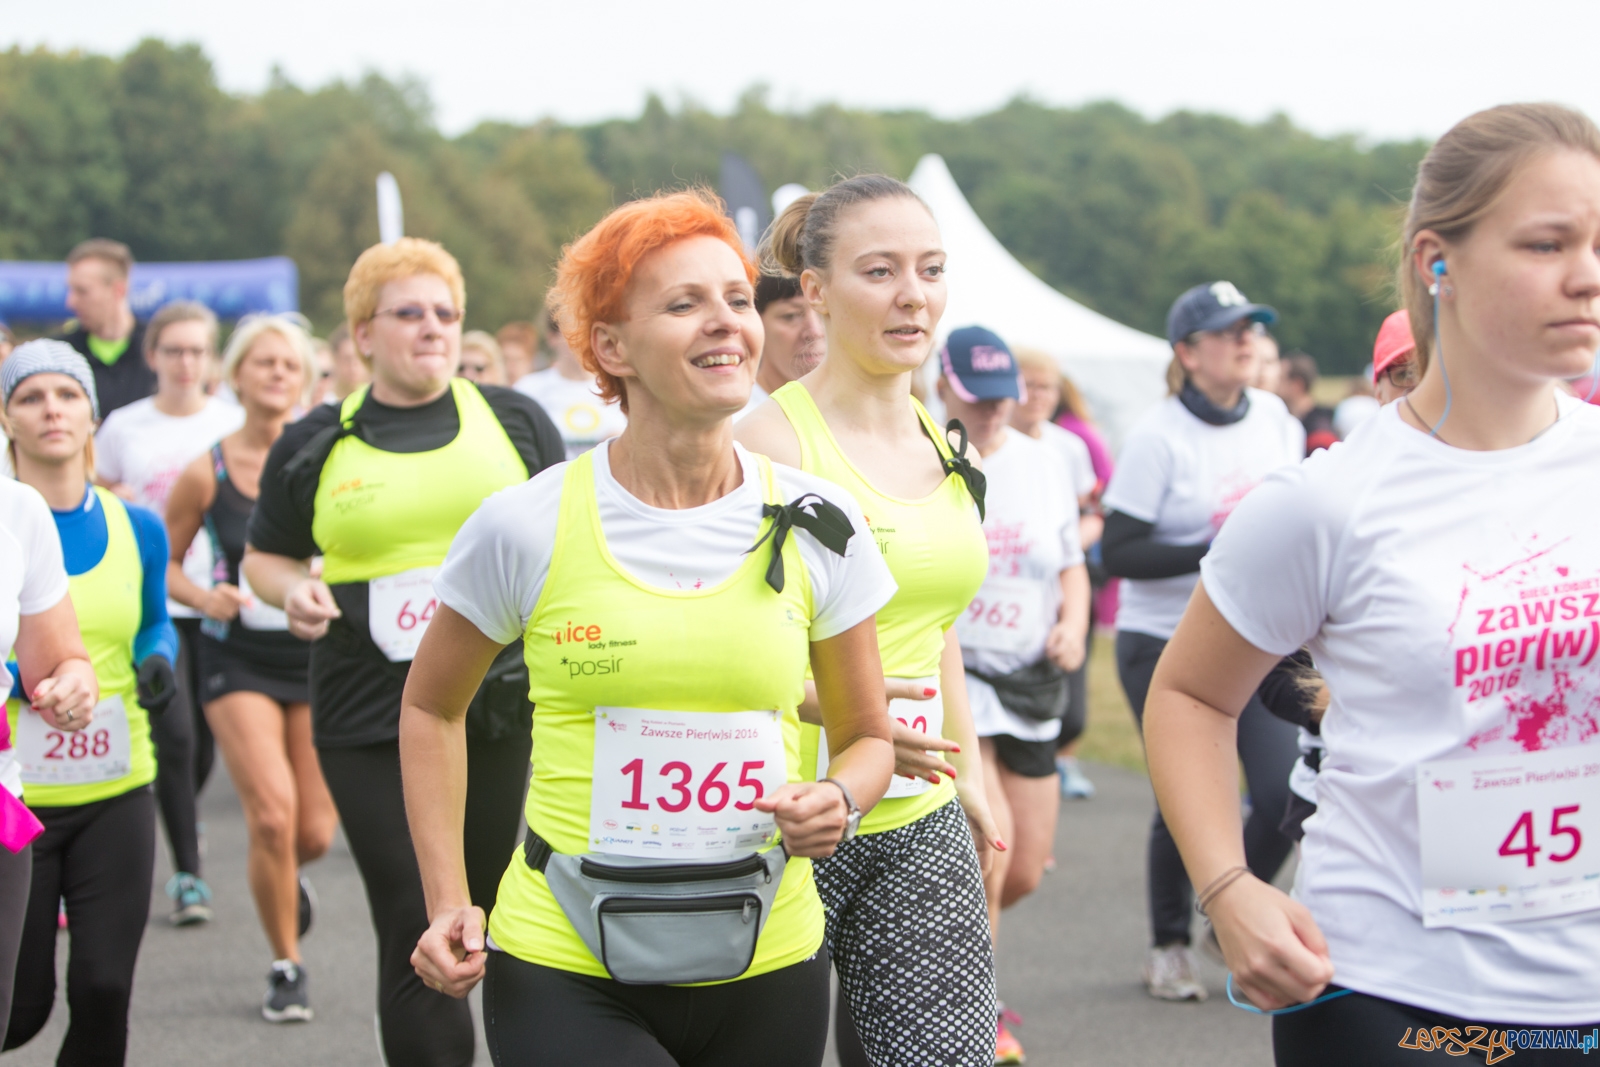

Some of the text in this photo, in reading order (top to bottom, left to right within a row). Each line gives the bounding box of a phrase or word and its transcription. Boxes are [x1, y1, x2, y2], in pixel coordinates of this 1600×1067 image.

[968, 597, 1021, 629] 962
[1477, 592, 1600, 635] zawsz
[588, 640, 637, 650] lady fitness
[1468, 668, 1522, 703] 2016
[44, 729, 110, 760] 288
[641, 725, 683, 739] Zawsze
[686, 728, 732, 741] Pier(w)si
[735, 727, 759, 740] 2016
[620, 758, 765, 813] 1365
[1473, 776, 1521, 791] Zawsze
[1498, 803, 1583, 868] 45
